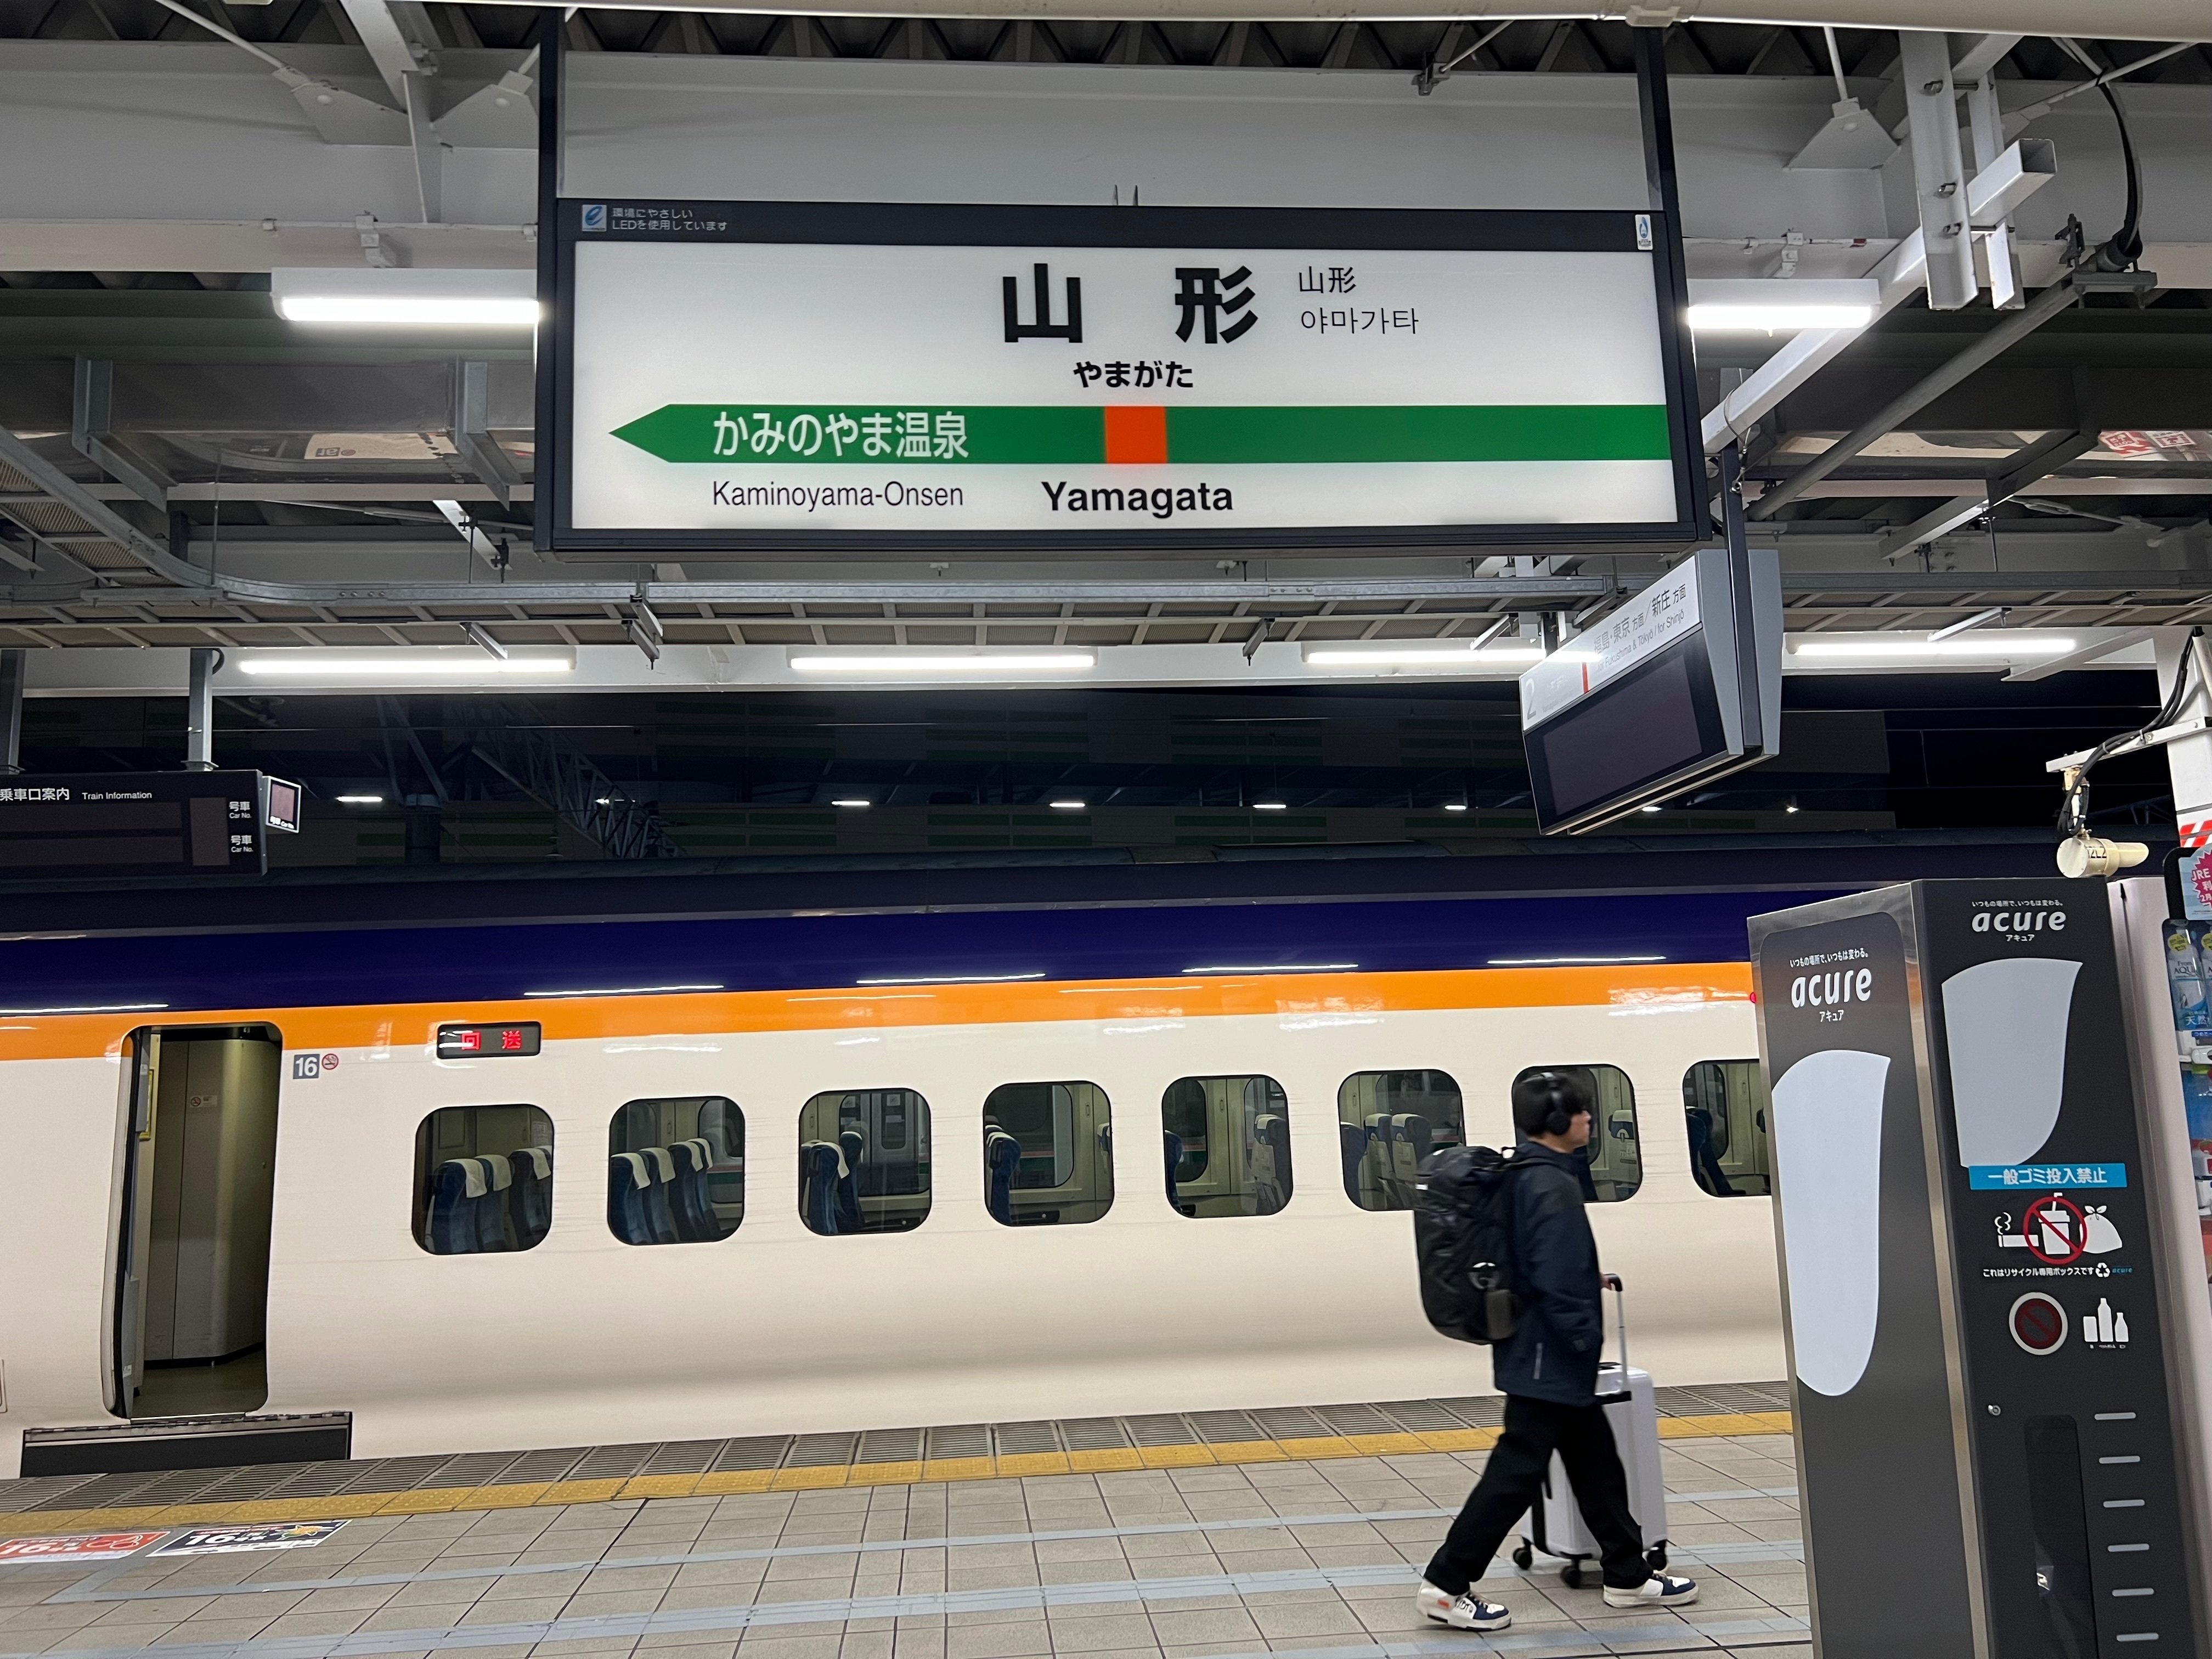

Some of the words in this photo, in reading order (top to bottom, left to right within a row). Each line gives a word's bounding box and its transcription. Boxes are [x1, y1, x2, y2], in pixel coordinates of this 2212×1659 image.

[612, 208, 692, 218] 環境にやさしい
[612, 220, 727, 231] LEDを使用しています
[1298, 266, 1357, 294] 山形
[1301, 307, 1419, 334] 야마가타
[1074, 360, 1193, 388] やまがた
[713, 411, 969, 459] かみのやま温泉
[713, 481, 964, 513] Kaminoyama-Onsen
[1041, 481, 1233, 520] Yamagata
[0, 787, 70, 801] 乗車口案内
[106, 791, 153, 799] Information
[229, 801, 251, 811] 号車
[231, 835, 252, 845] 号車
[2192, 868, 2211, 881] JRE
[1972, 911, 2067, 932] acure
[1790, 947, 1869, 968] いつもの場所で、いつもは変わる。
[2174, 966, 2200, 975] AQU
[1791, 968, 1872, 1008] acure
[1819, 1009, 1844, 1023] アキュア
[461, 1030, 521, 1051] 回送
[295, 1057, 318, 1077] 16
[1987, 1167, 2108, 1186] 一般ゴミ投入禁止
[1983, 1267, 2094, 1277] これはリサイクル専用ボックスです
